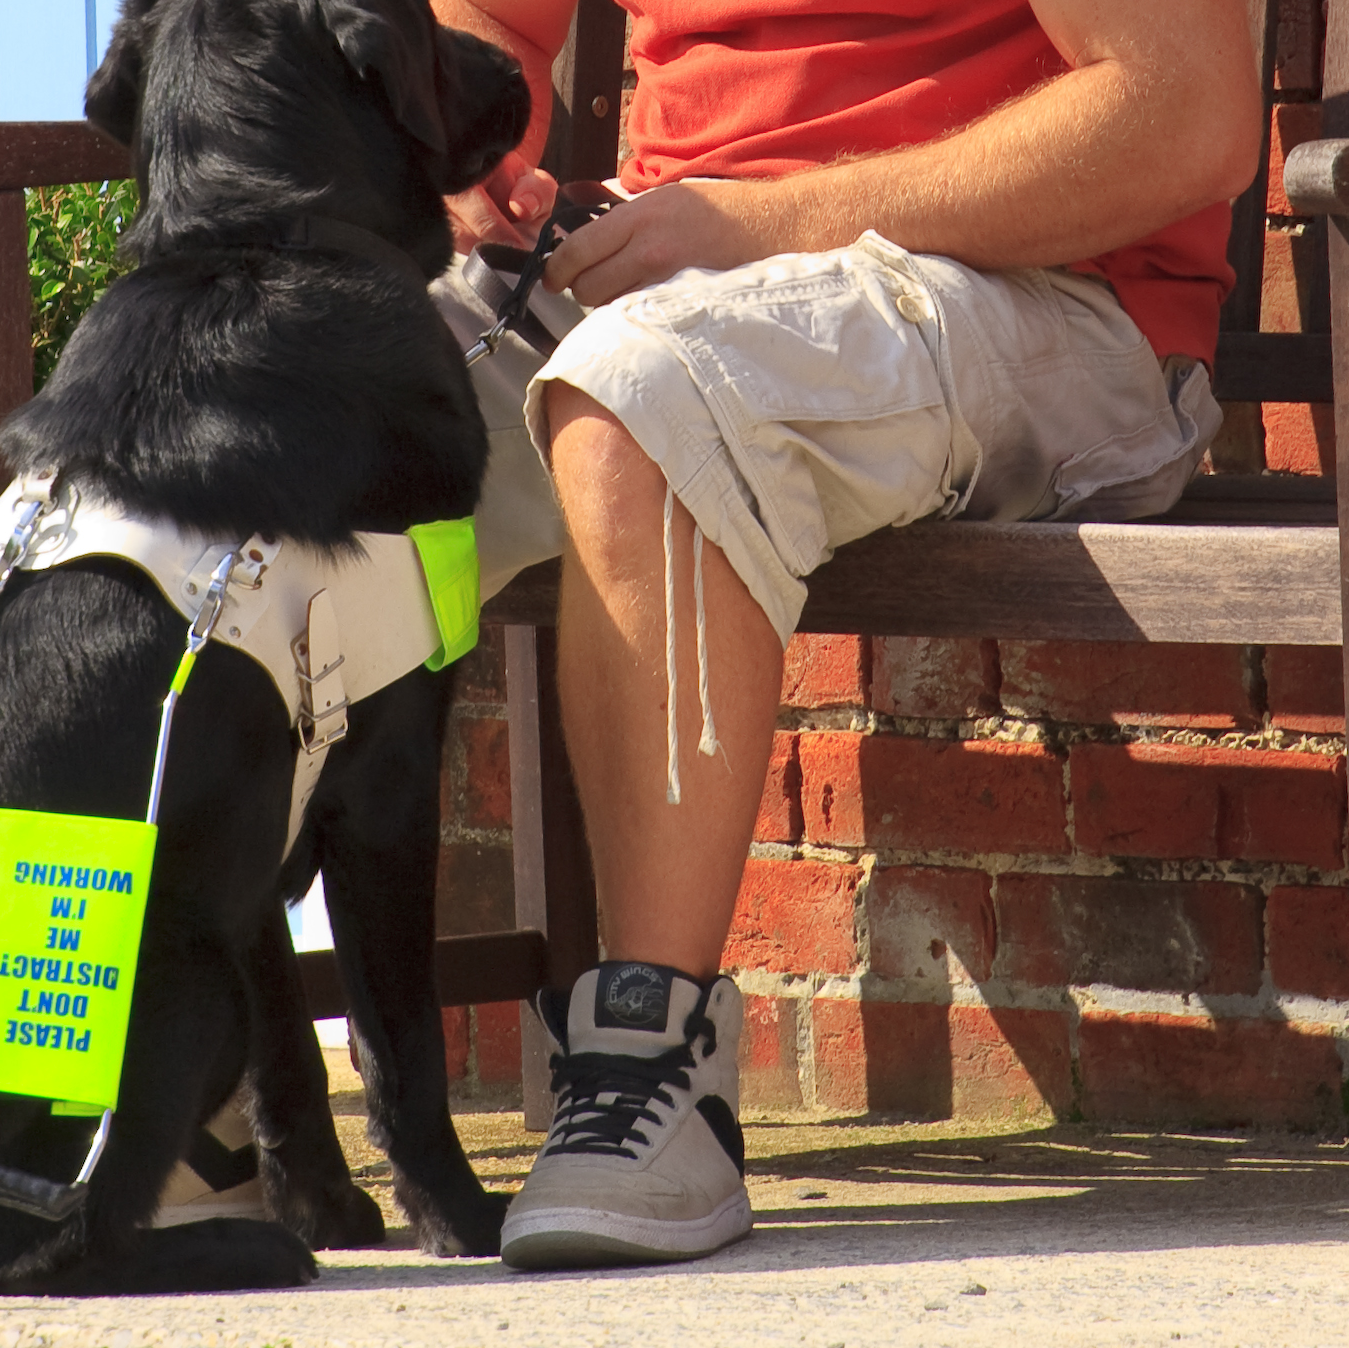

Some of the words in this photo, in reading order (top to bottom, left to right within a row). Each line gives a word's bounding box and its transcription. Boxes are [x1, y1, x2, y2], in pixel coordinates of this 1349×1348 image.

[14, 861, 133, 894] WORKING
[50, 897, 87, 919] I'M
[46, 927, 81, 951] ME
[17, 989, 89, 1018] DON'T
[5, 1020, 91, 1052] PLEASE
